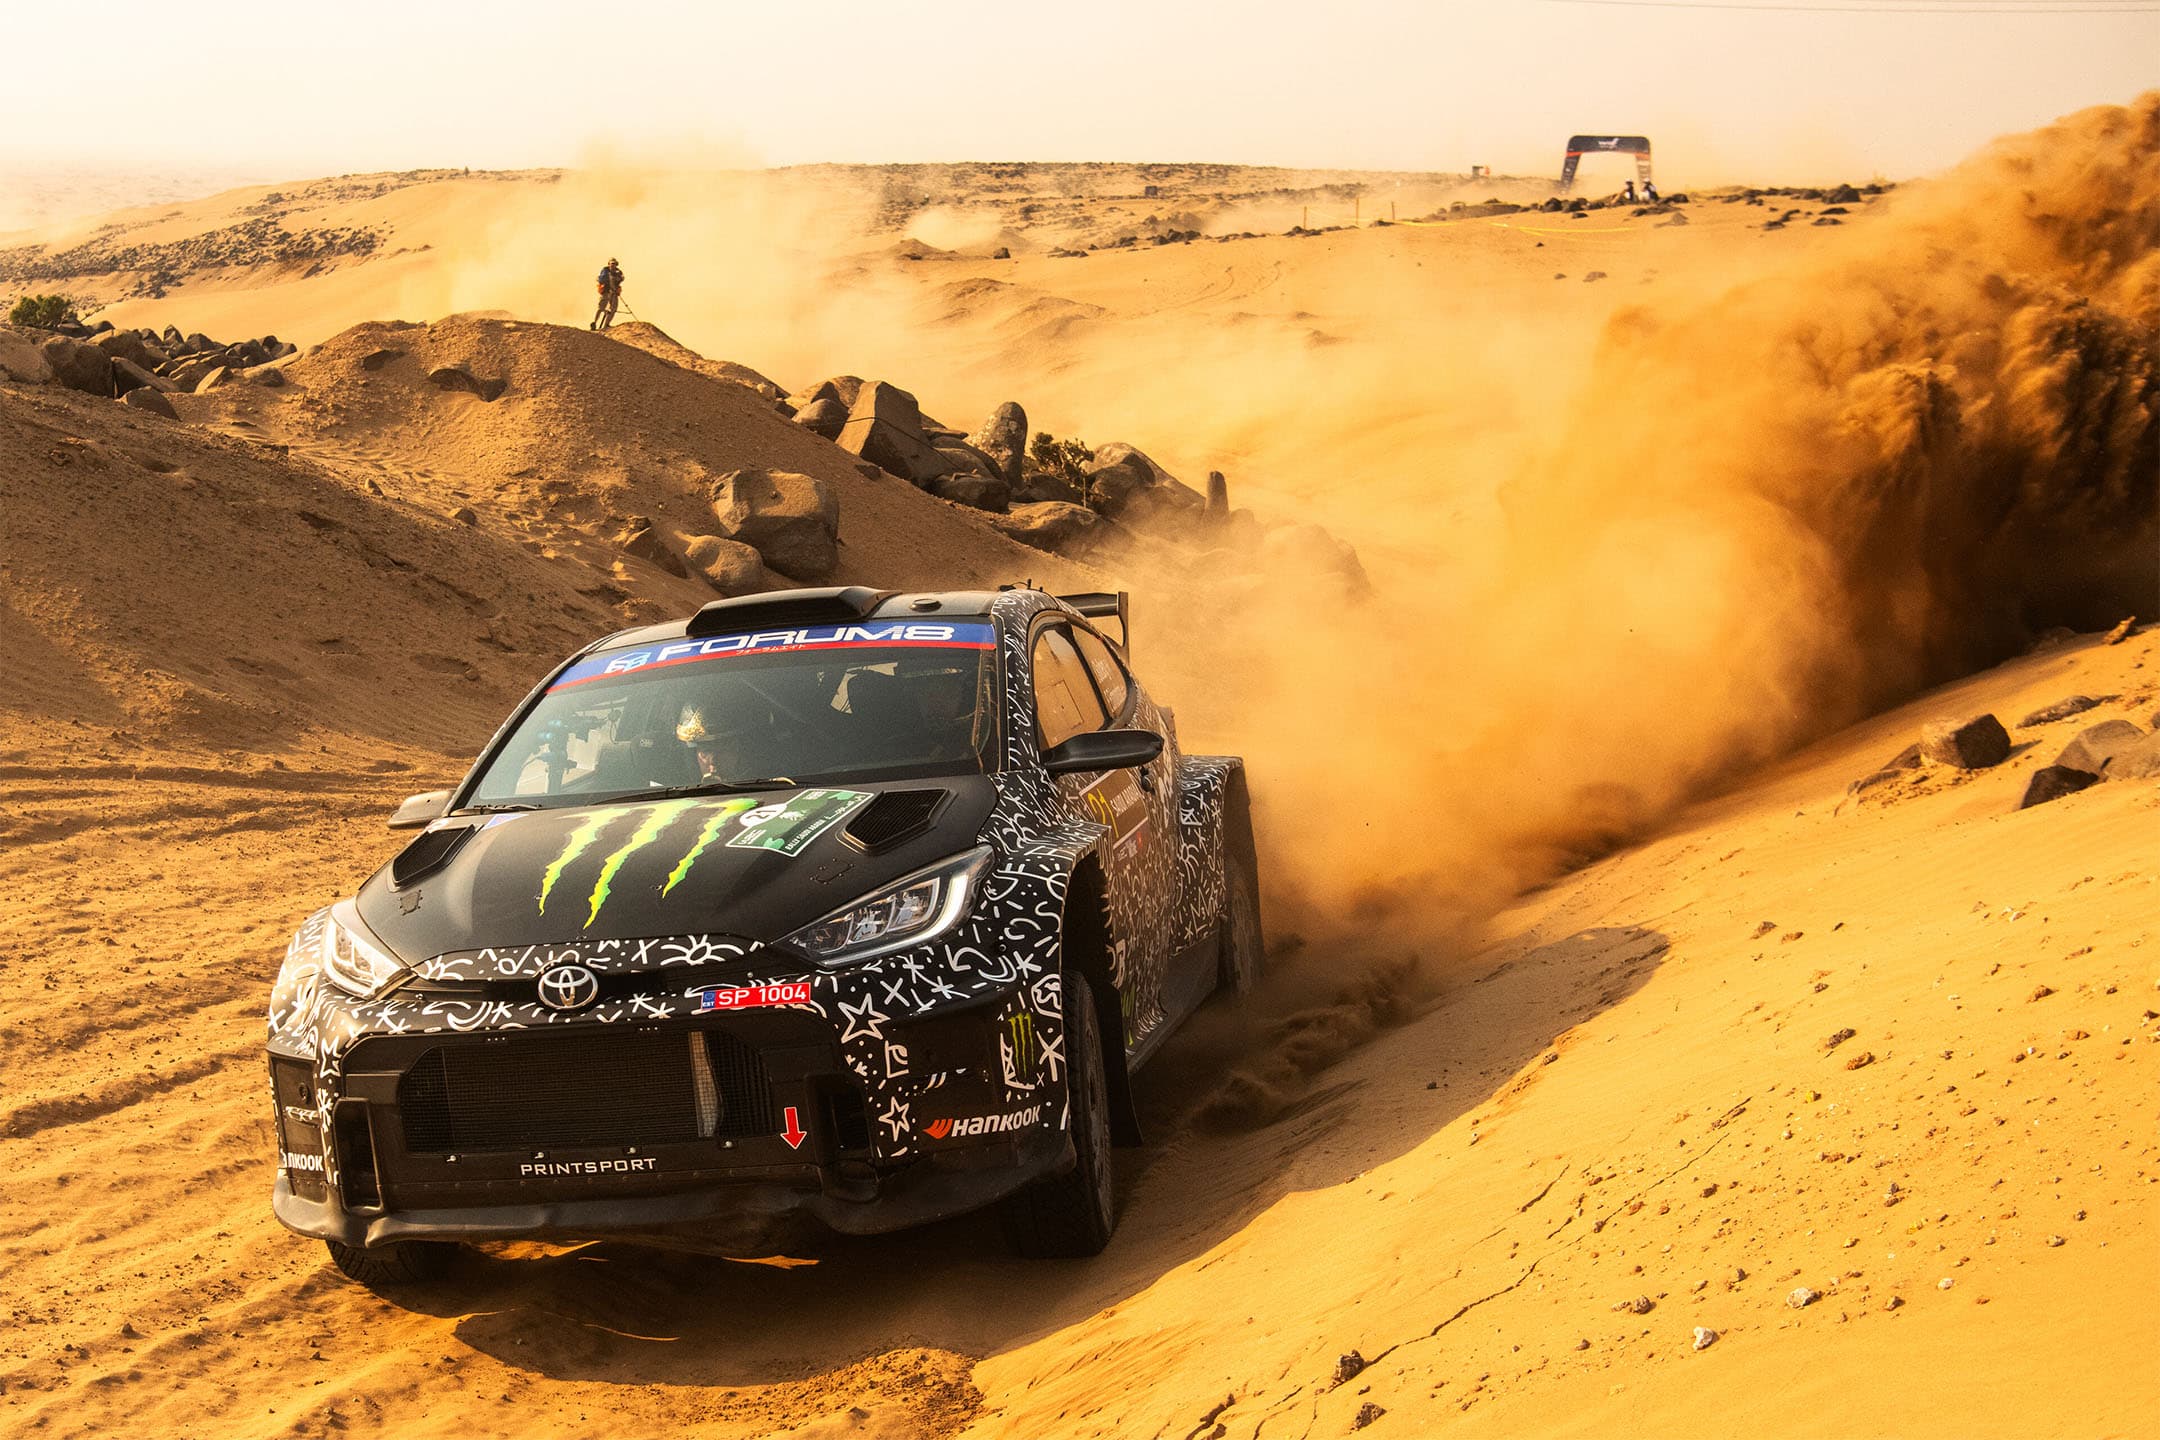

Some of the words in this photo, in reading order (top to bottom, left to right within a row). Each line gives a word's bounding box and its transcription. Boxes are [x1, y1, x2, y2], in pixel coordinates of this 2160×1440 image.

[656, 626, 955, 662] FORUM8
[745, 810, 777, 819] 21
[719, 990, 750, 1005] SP
[759, 985, 806, 1002] 1004
[520, 1158, 656, 1175] PRINTSPORT
